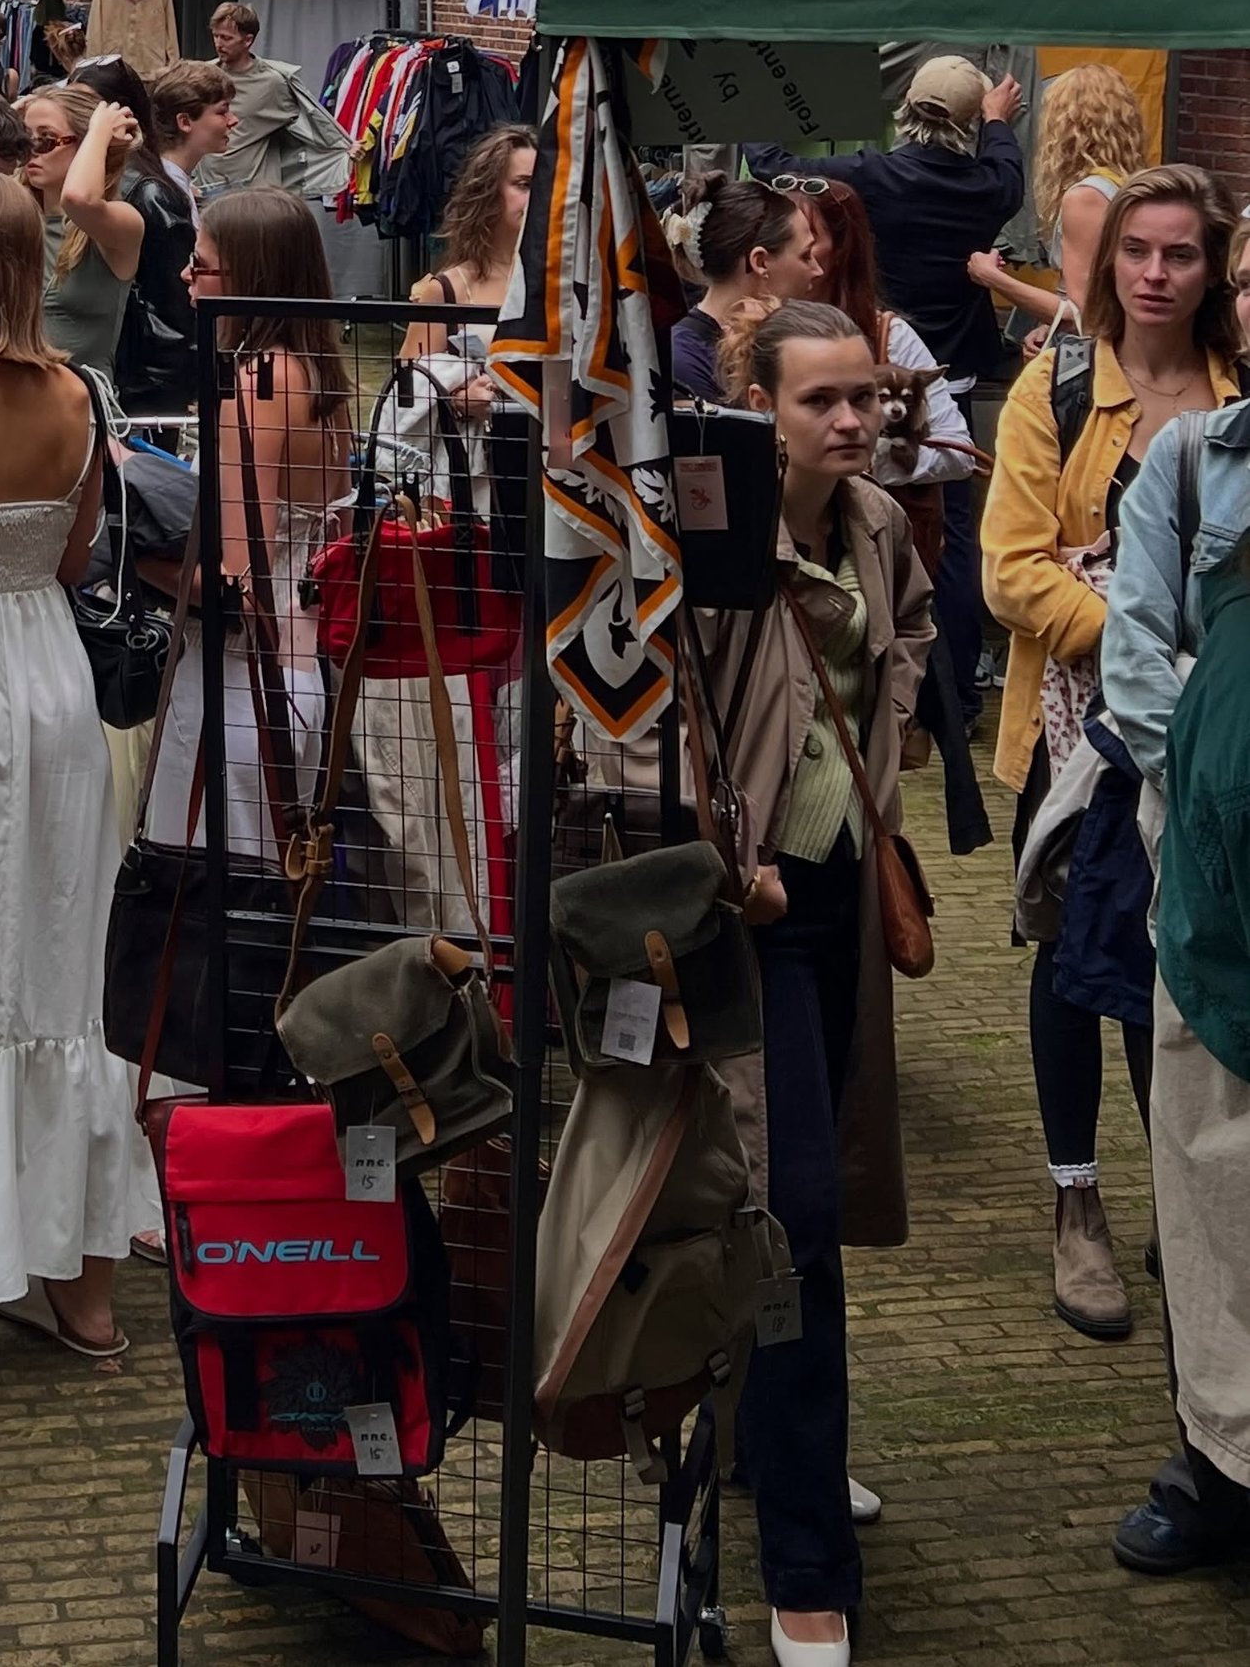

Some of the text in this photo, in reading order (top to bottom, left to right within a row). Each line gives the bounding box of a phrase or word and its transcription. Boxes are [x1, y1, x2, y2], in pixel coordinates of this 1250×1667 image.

[712, 72, 740, 103] by
[782, 82, 820, 136] Folie
[362, 1174, 377, 1190] 15
[197, 1240, 380, 1264] O'NEILL
[370, 1446, 385, 1460] 15
